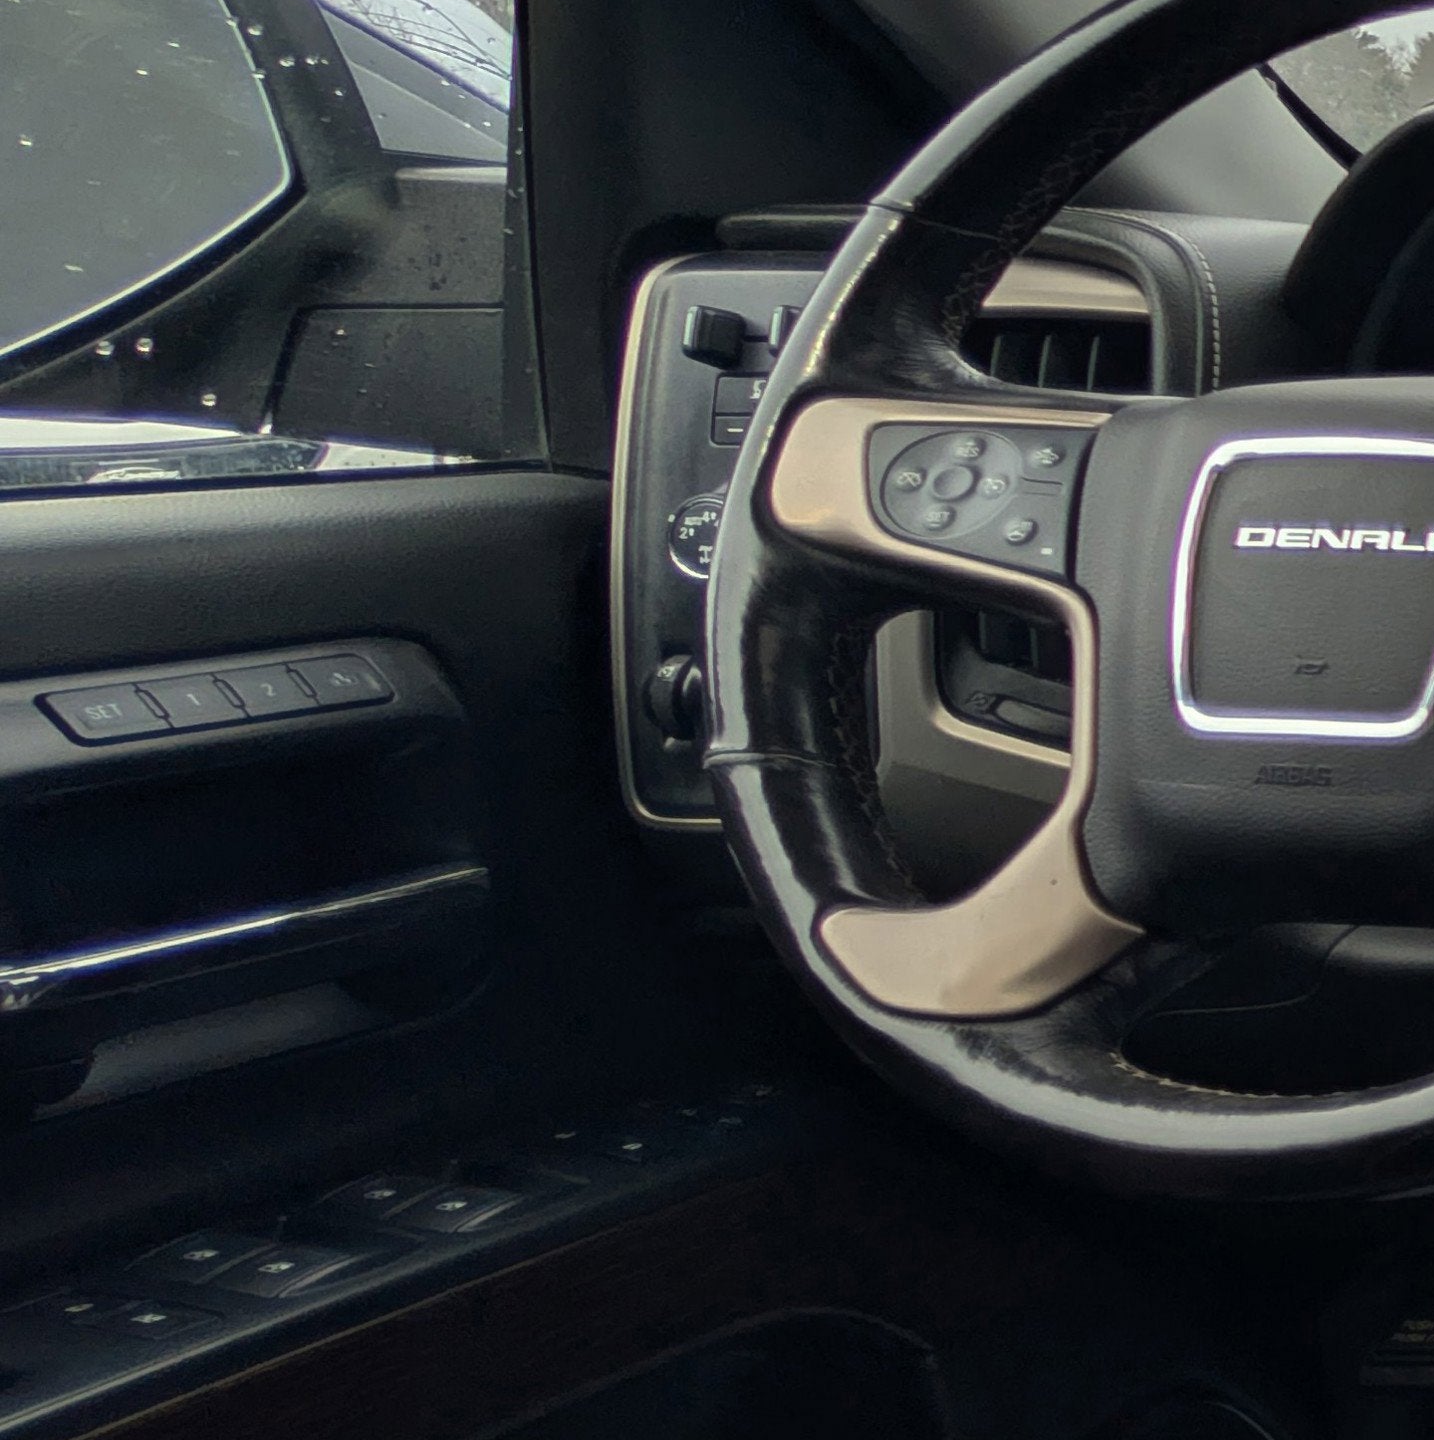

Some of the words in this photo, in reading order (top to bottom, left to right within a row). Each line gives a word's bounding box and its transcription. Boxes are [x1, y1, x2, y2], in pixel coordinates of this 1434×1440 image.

[261, 683, 275, 696] 2
[186, 692, 202, 707] 1
[85, 703, 122, 721] SET
